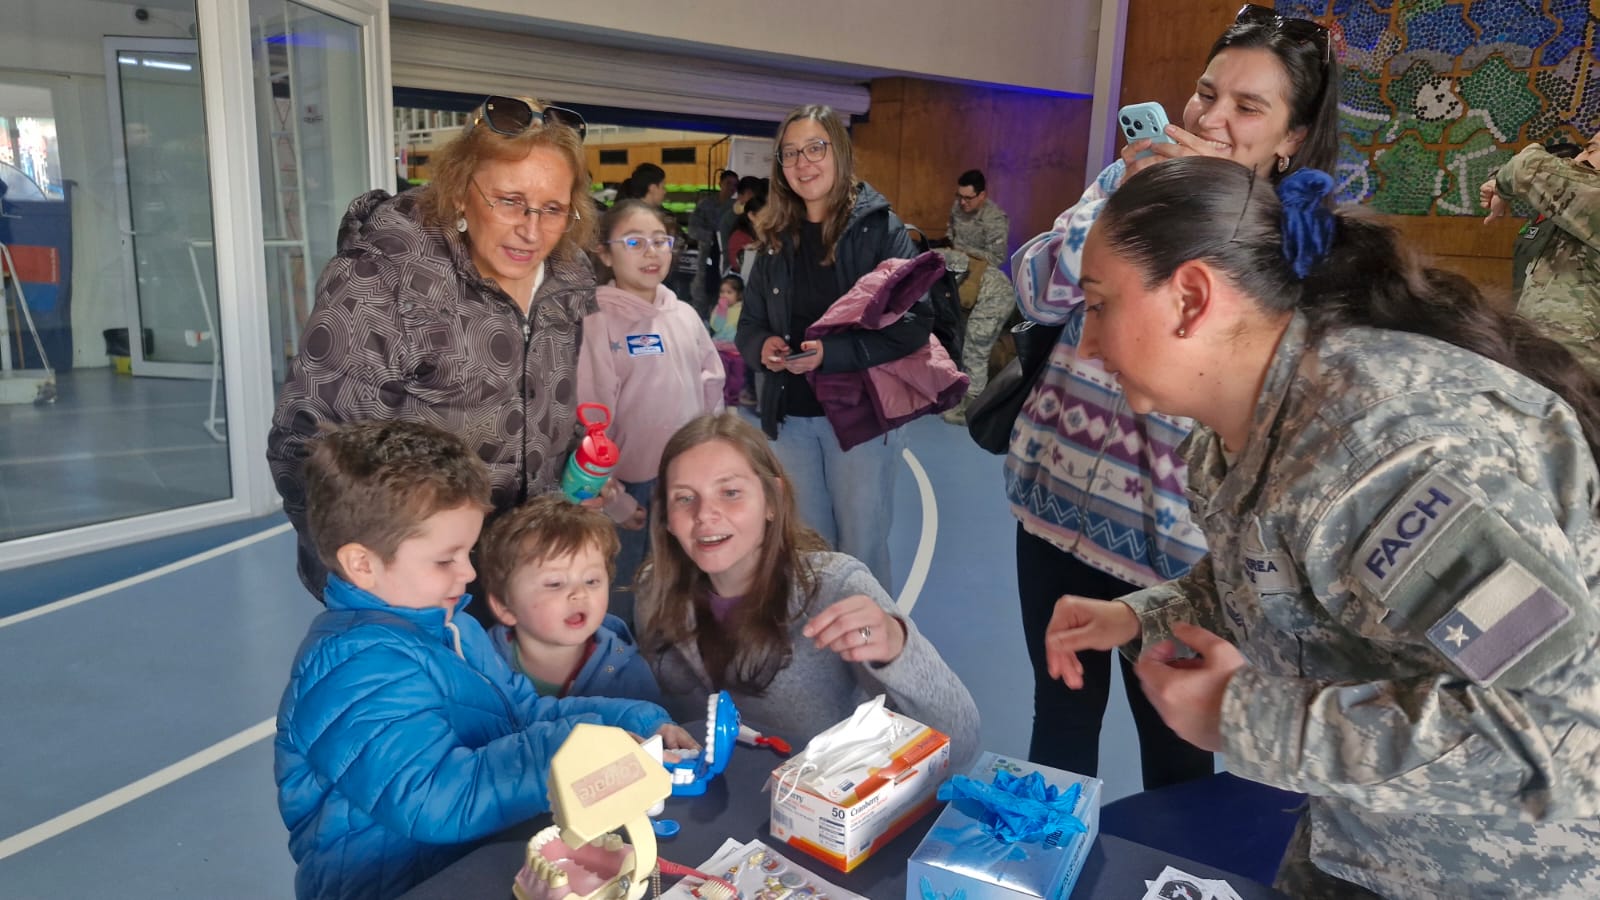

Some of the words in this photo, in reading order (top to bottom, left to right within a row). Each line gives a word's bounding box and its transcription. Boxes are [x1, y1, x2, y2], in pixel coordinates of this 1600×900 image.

[1366, 487, 1452, 580] FACH
[579, 757, 641, 801] Colgate
[832, 807, 845, 819] 50
[850, 793, 880, 817] Cranberry
